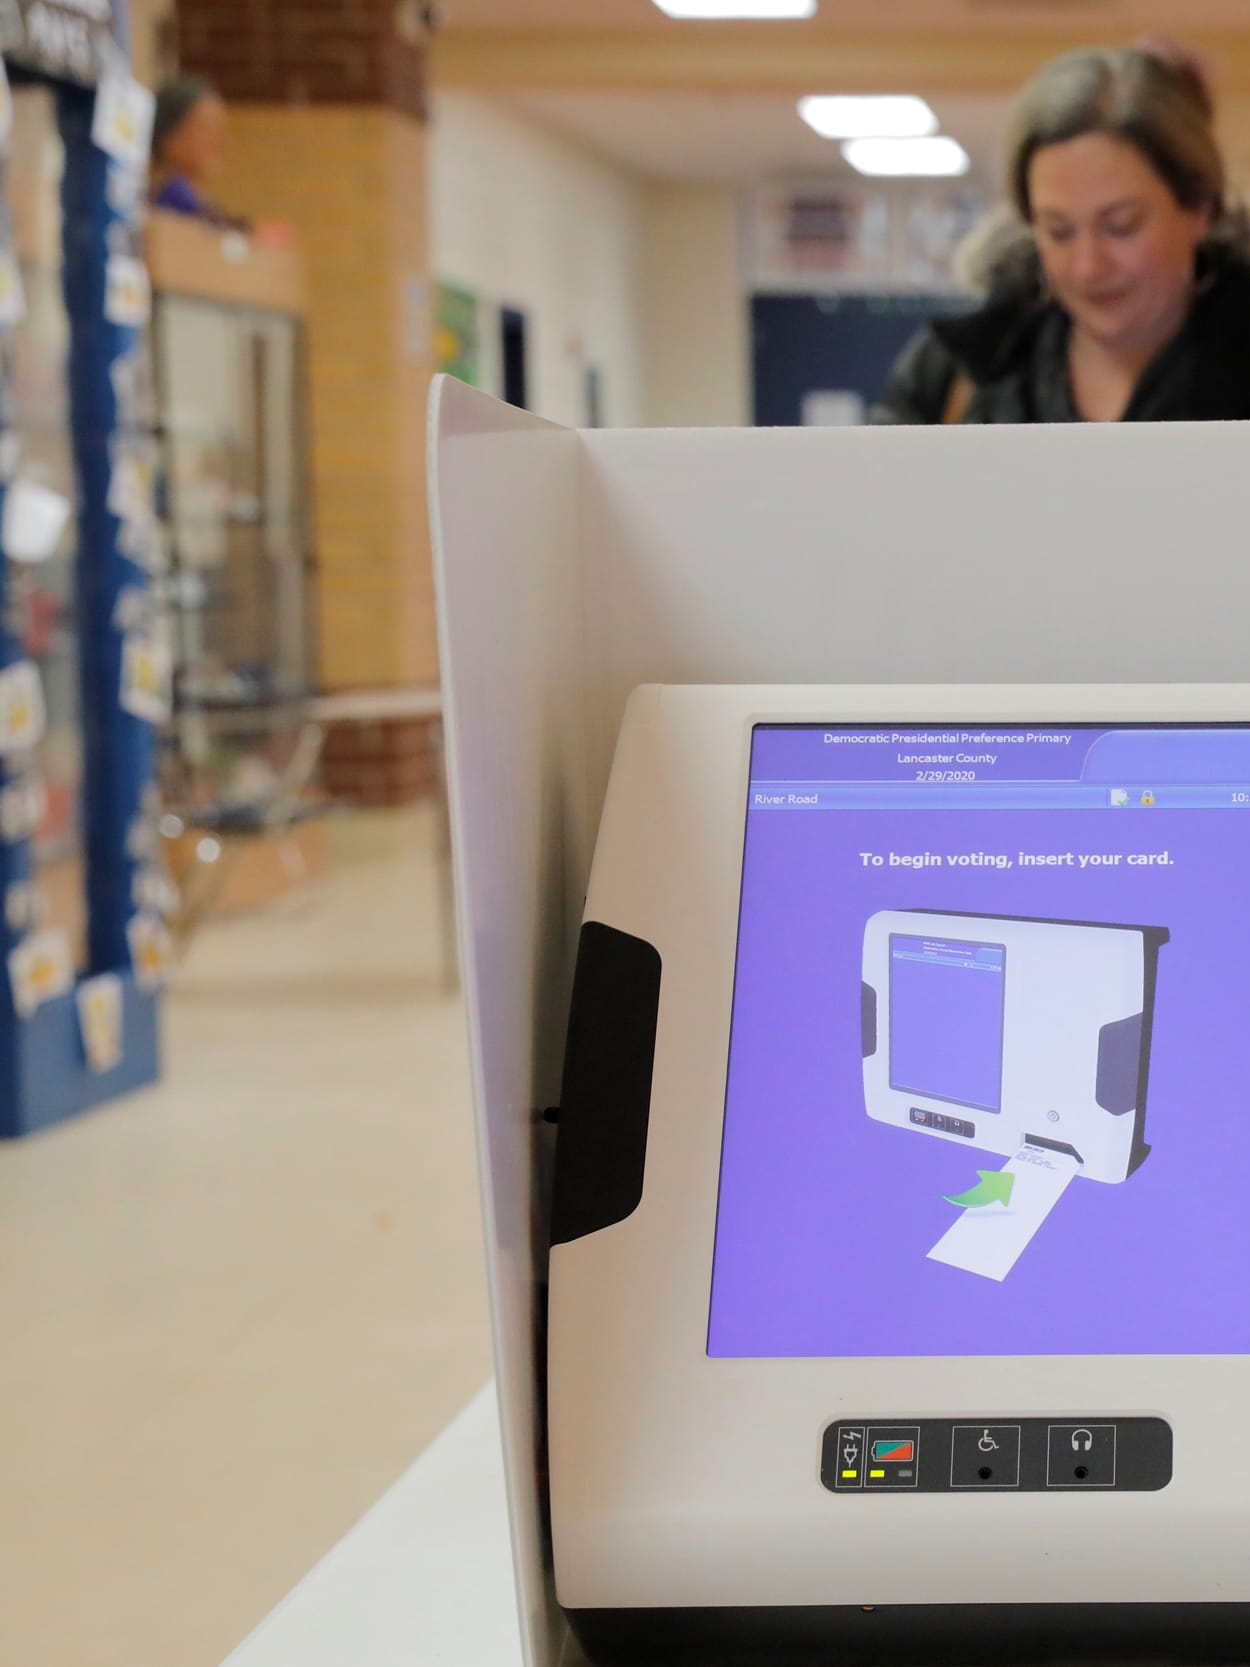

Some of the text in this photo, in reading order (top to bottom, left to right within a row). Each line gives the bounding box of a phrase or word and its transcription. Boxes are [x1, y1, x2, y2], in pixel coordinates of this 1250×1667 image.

[823, 733, 1072, 745] Democratic Presidential Preference Primary
[897, 753, 997, 765] Lancaster County
[916, 770, 976, 782] 2/29/2020
[754, 793, 818, 804] River Road
[860, 851, 1175, 869] To begin voting, insert your card.
